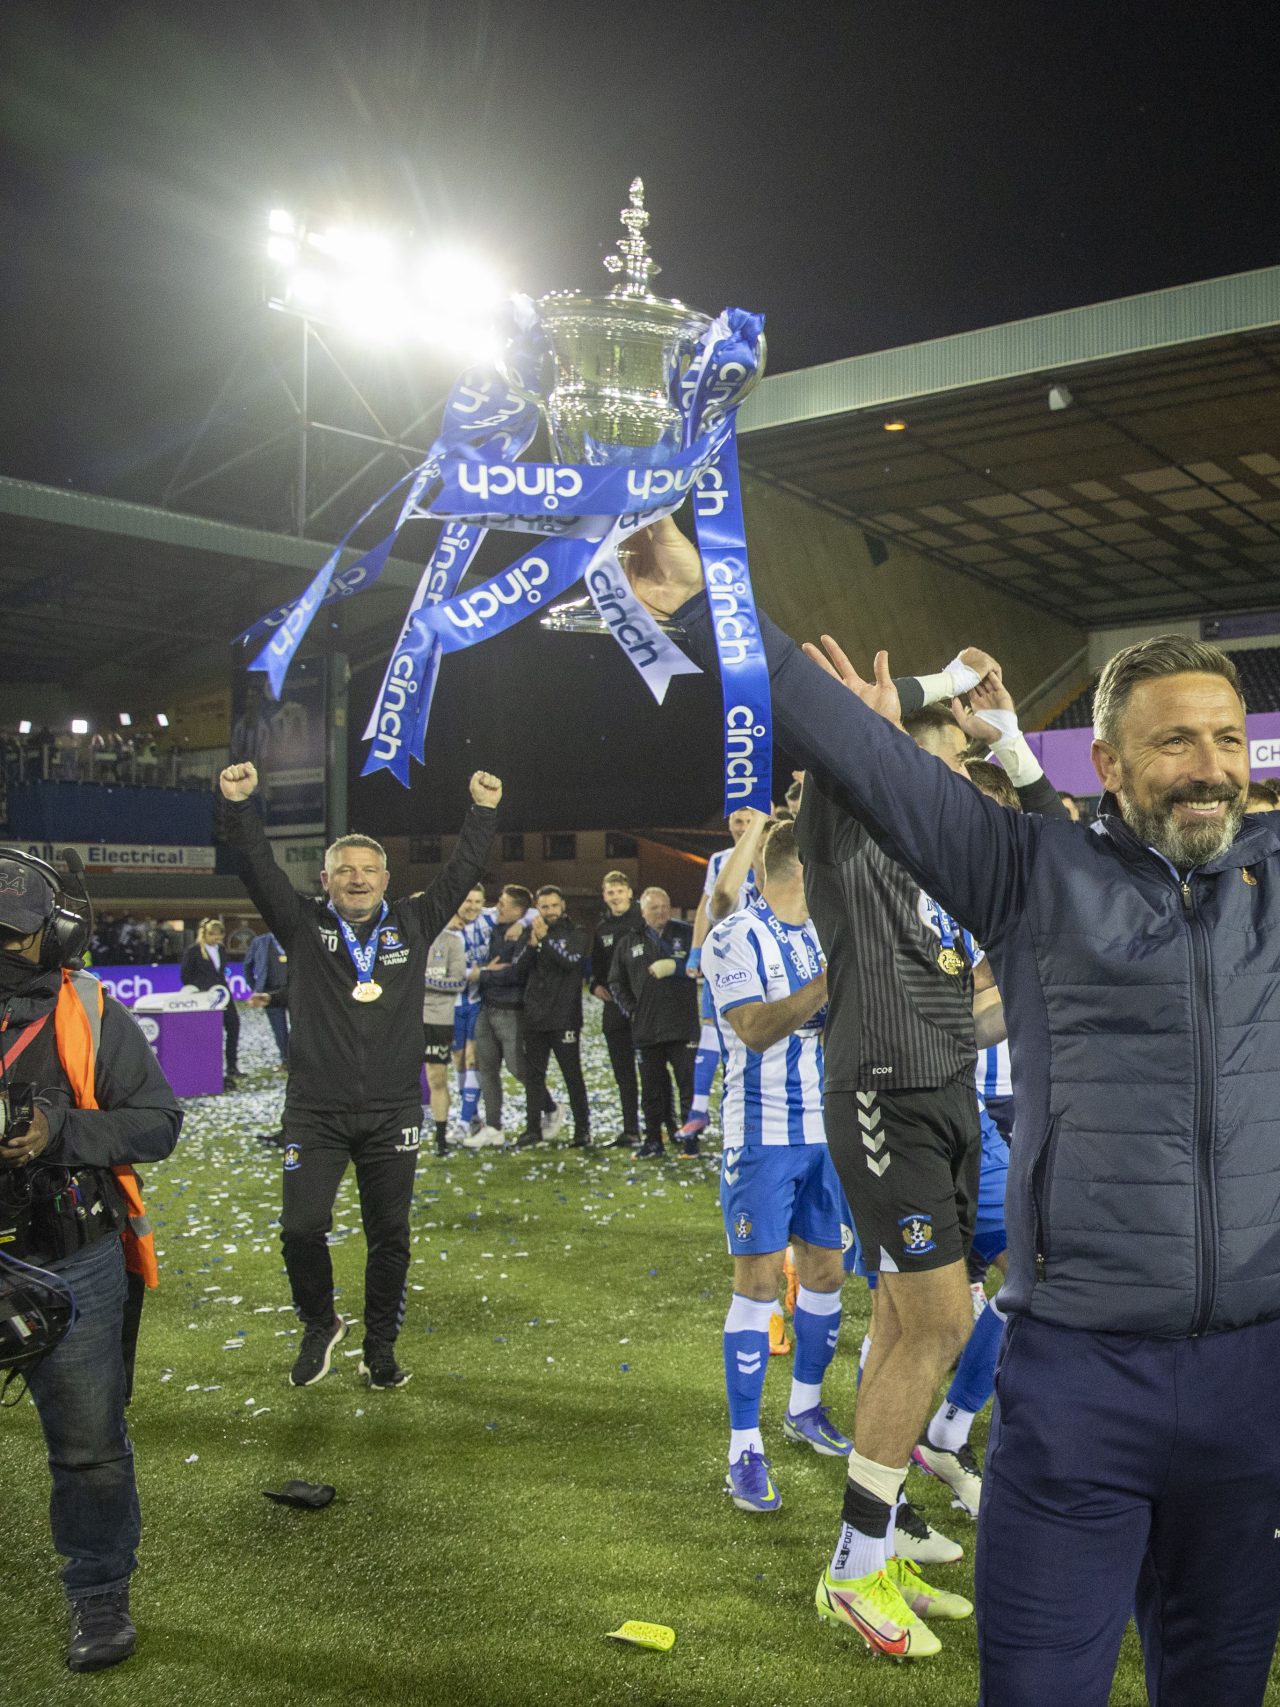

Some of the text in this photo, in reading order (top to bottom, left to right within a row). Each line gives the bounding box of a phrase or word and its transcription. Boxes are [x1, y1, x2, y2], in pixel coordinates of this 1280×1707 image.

[458, 462, 583, 510] cinch
[443, 556, 550, 629] cinch
[589, 570, 660, 668] cinch
[706, 561, 751, 666] cinch
[373, 654, 418, 761] cinch
[727, 705, 766, 799] cinch
[27, 845, 66, 863] Alla
[88, 846, 184, 864] Electrical
[768, 915, 789, 944] cinch
[378, 949, 410, 962] HAMILTO
[789, 950, 809, 980] cinch
[806, 945, 819, 974] cinch
[721, 971, 747, 984] cinch
[168, 999, 199, 1010] cinch
[401, 1126, 419, 1146] TD
